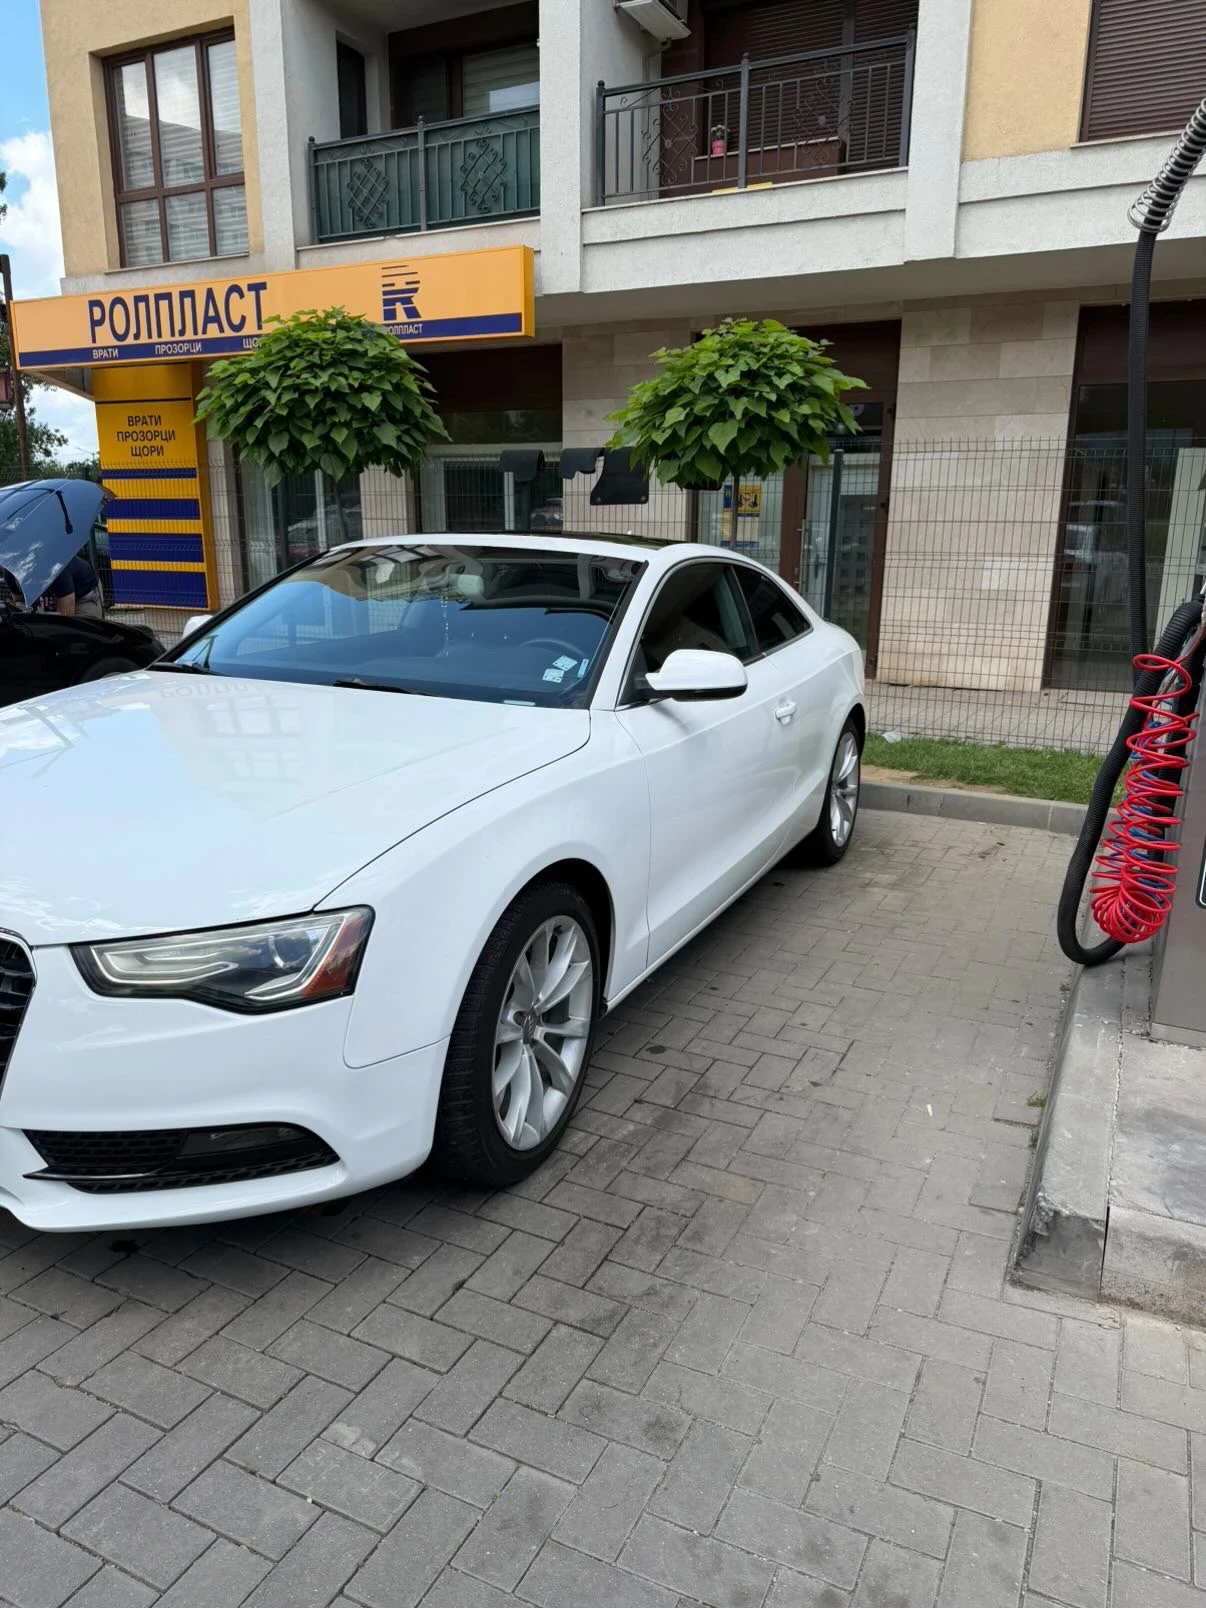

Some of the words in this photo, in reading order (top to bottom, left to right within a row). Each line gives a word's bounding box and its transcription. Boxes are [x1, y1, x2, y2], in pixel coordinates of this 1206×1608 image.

[87, 281, 268, 344] РОЛПЛАСТ
[386, 323, 424, 336] ОЛПЛАСТ
[92, 348, 119, 359] ВРАТИ
[155, 342, 203, 355] ПРОЗОРЦИ
[242, 336, 263, 350] ЩО
[127, 415, 162, 428] ВРАТИ
[116, 430, 176, 443] ПРОЗОРЦИ
[130, 445, 165, 458] ЩОРИ
